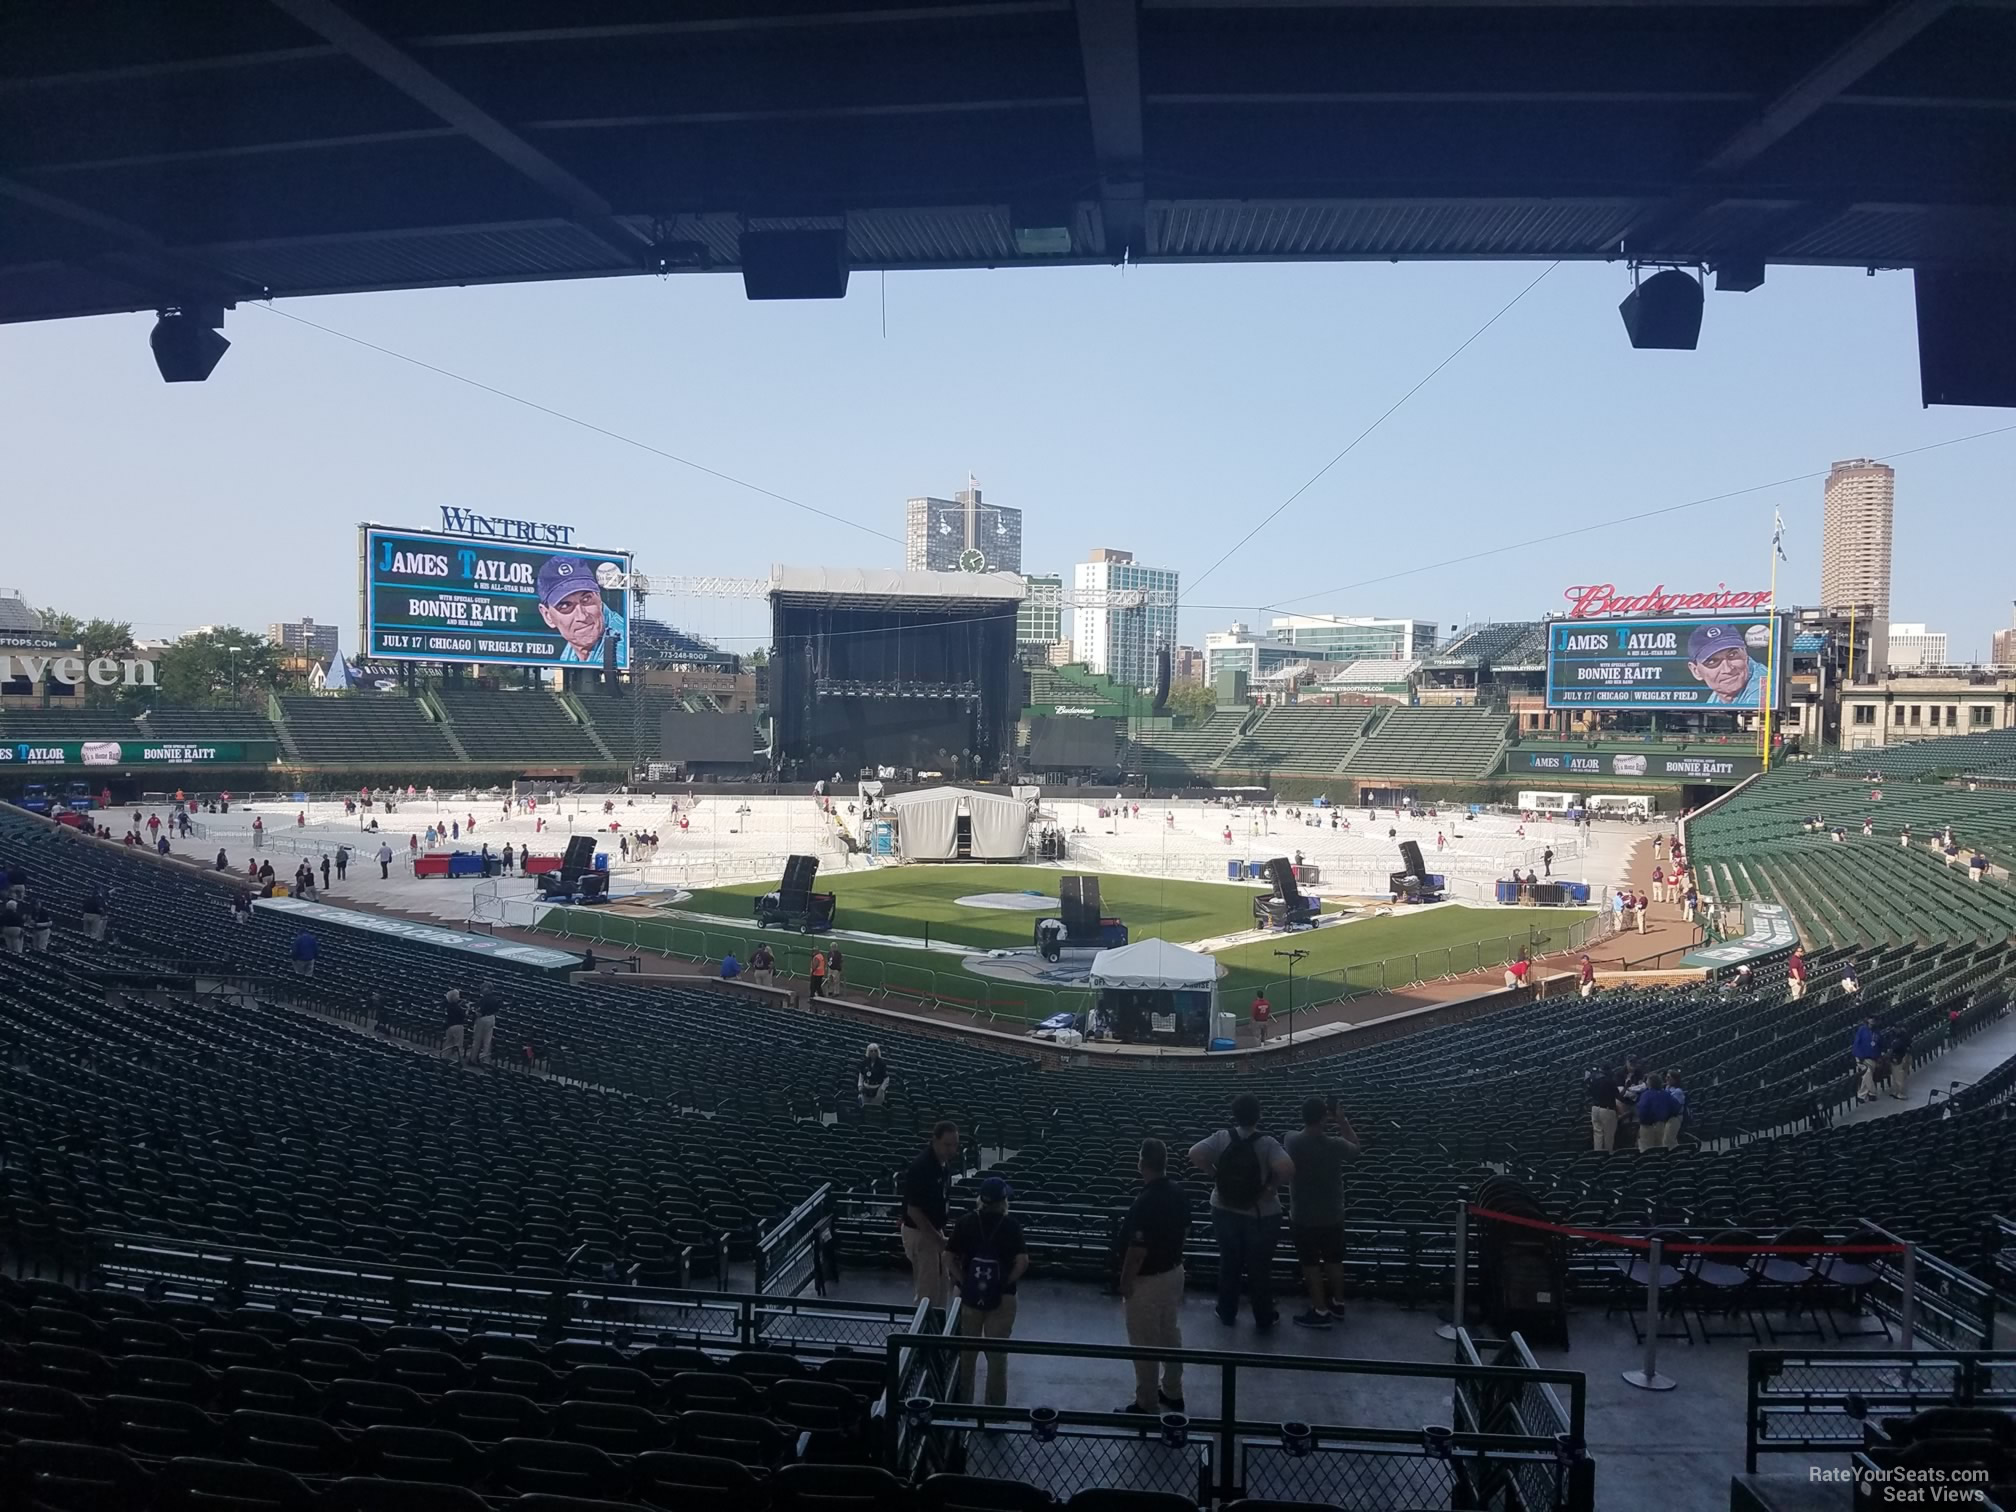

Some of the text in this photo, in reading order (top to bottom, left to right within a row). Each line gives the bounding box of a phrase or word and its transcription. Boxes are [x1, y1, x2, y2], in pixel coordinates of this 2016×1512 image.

[440, 505, 575, 545] WINTRUST
[379, 542, 535, 584] JAMES TAYLOR
[490, 584, 519, 592] ALL-STAR
[1564, 583, 1772, 618] Budweiser
[409, 599, 518, 622] BONNIE RAITT
[382, 635, 555, 655] JULY 17 CHICAGO WRIGLEY FIELD
[1558, 628, 1677, 650] JAMES TAYLOR
[1577, 667, 1662, 680] BONNIE RAITT
[1563, 692, 1698, 700] JULY 17 CHICAGO WRIGLEY FIELD
[1055, 705, 1096, 714] Budweiser
[18, 744, 65, 760] TAYLOR
[144, 748, 216, 759] BONNIE RAITT
[1530, 752, 1599, 768] JAMES TAYLOR
[1666, 762, 1733, 773] BONNIE RAITT
[319, 912, 474, 945] CHICAGO CUBS
